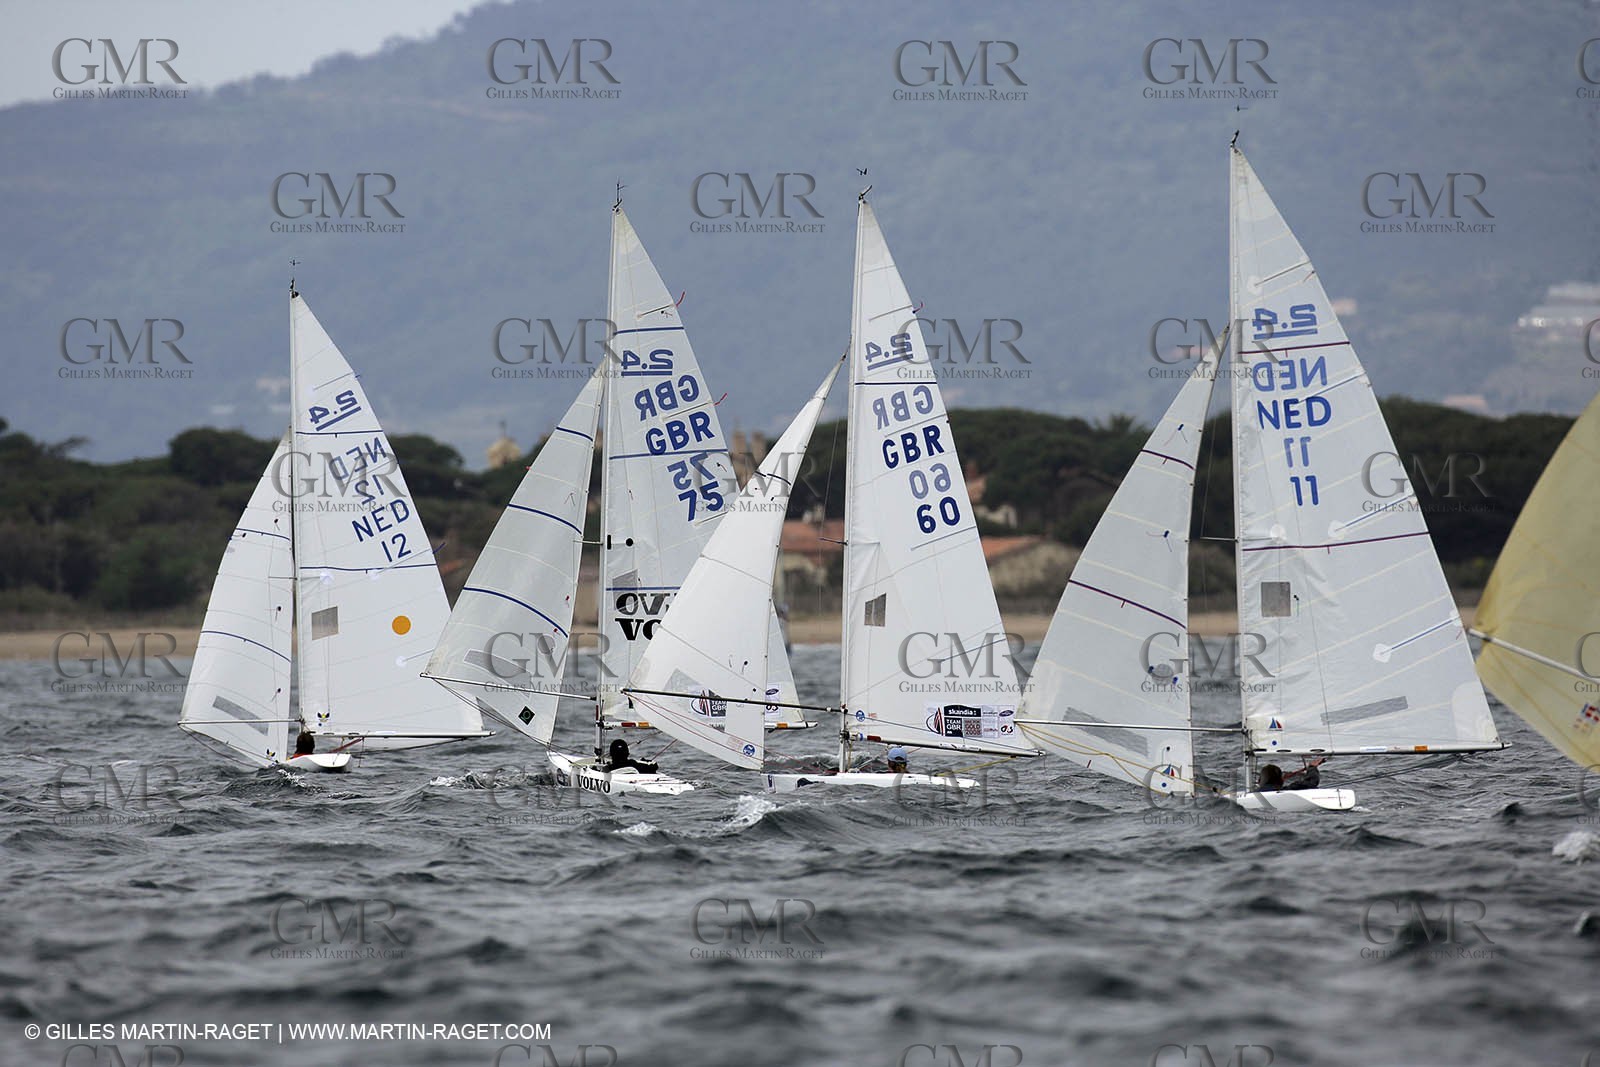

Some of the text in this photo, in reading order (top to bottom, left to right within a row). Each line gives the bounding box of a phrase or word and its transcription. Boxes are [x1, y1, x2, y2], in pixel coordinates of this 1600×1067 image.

[1257, 396, 1332, 430] NED
[646, 411, 715, 455] GBR
[882, 424, 945, 469] GBR
[678, 481, 724, 521] 75
[1290, 475, 1319, 506] 11
[352, 499, 410, 542] NED
[917, 496, 961, 534] 60
[381, 533, 411, 562] 12
[576, 774, 611, 793] VOLVO
